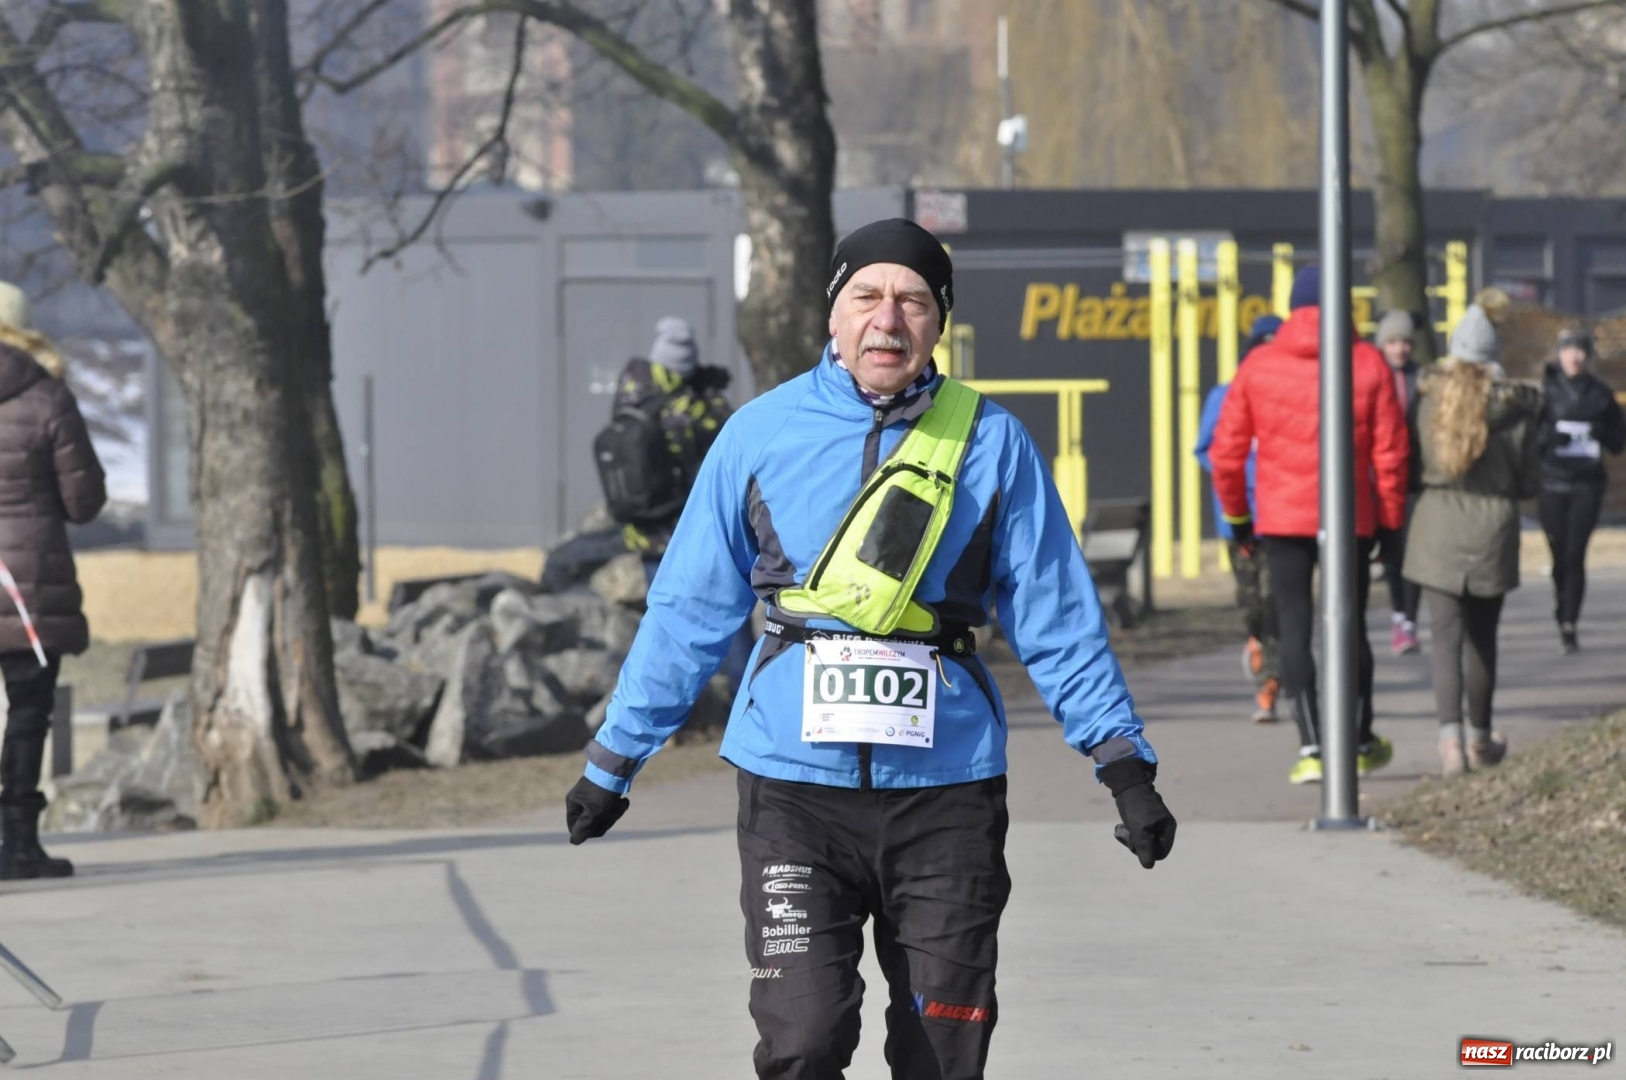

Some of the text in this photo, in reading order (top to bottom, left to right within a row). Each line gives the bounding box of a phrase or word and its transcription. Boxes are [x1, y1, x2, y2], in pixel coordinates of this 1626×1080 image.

[1020, 282, 1151, 340] Plaża
[819, 667, 924, 707] 0102
[768, 864, 813, 875] MADSHUS
[762, 924, 812, 938] Bobillier
[763, 938, 810, 956] BMC
